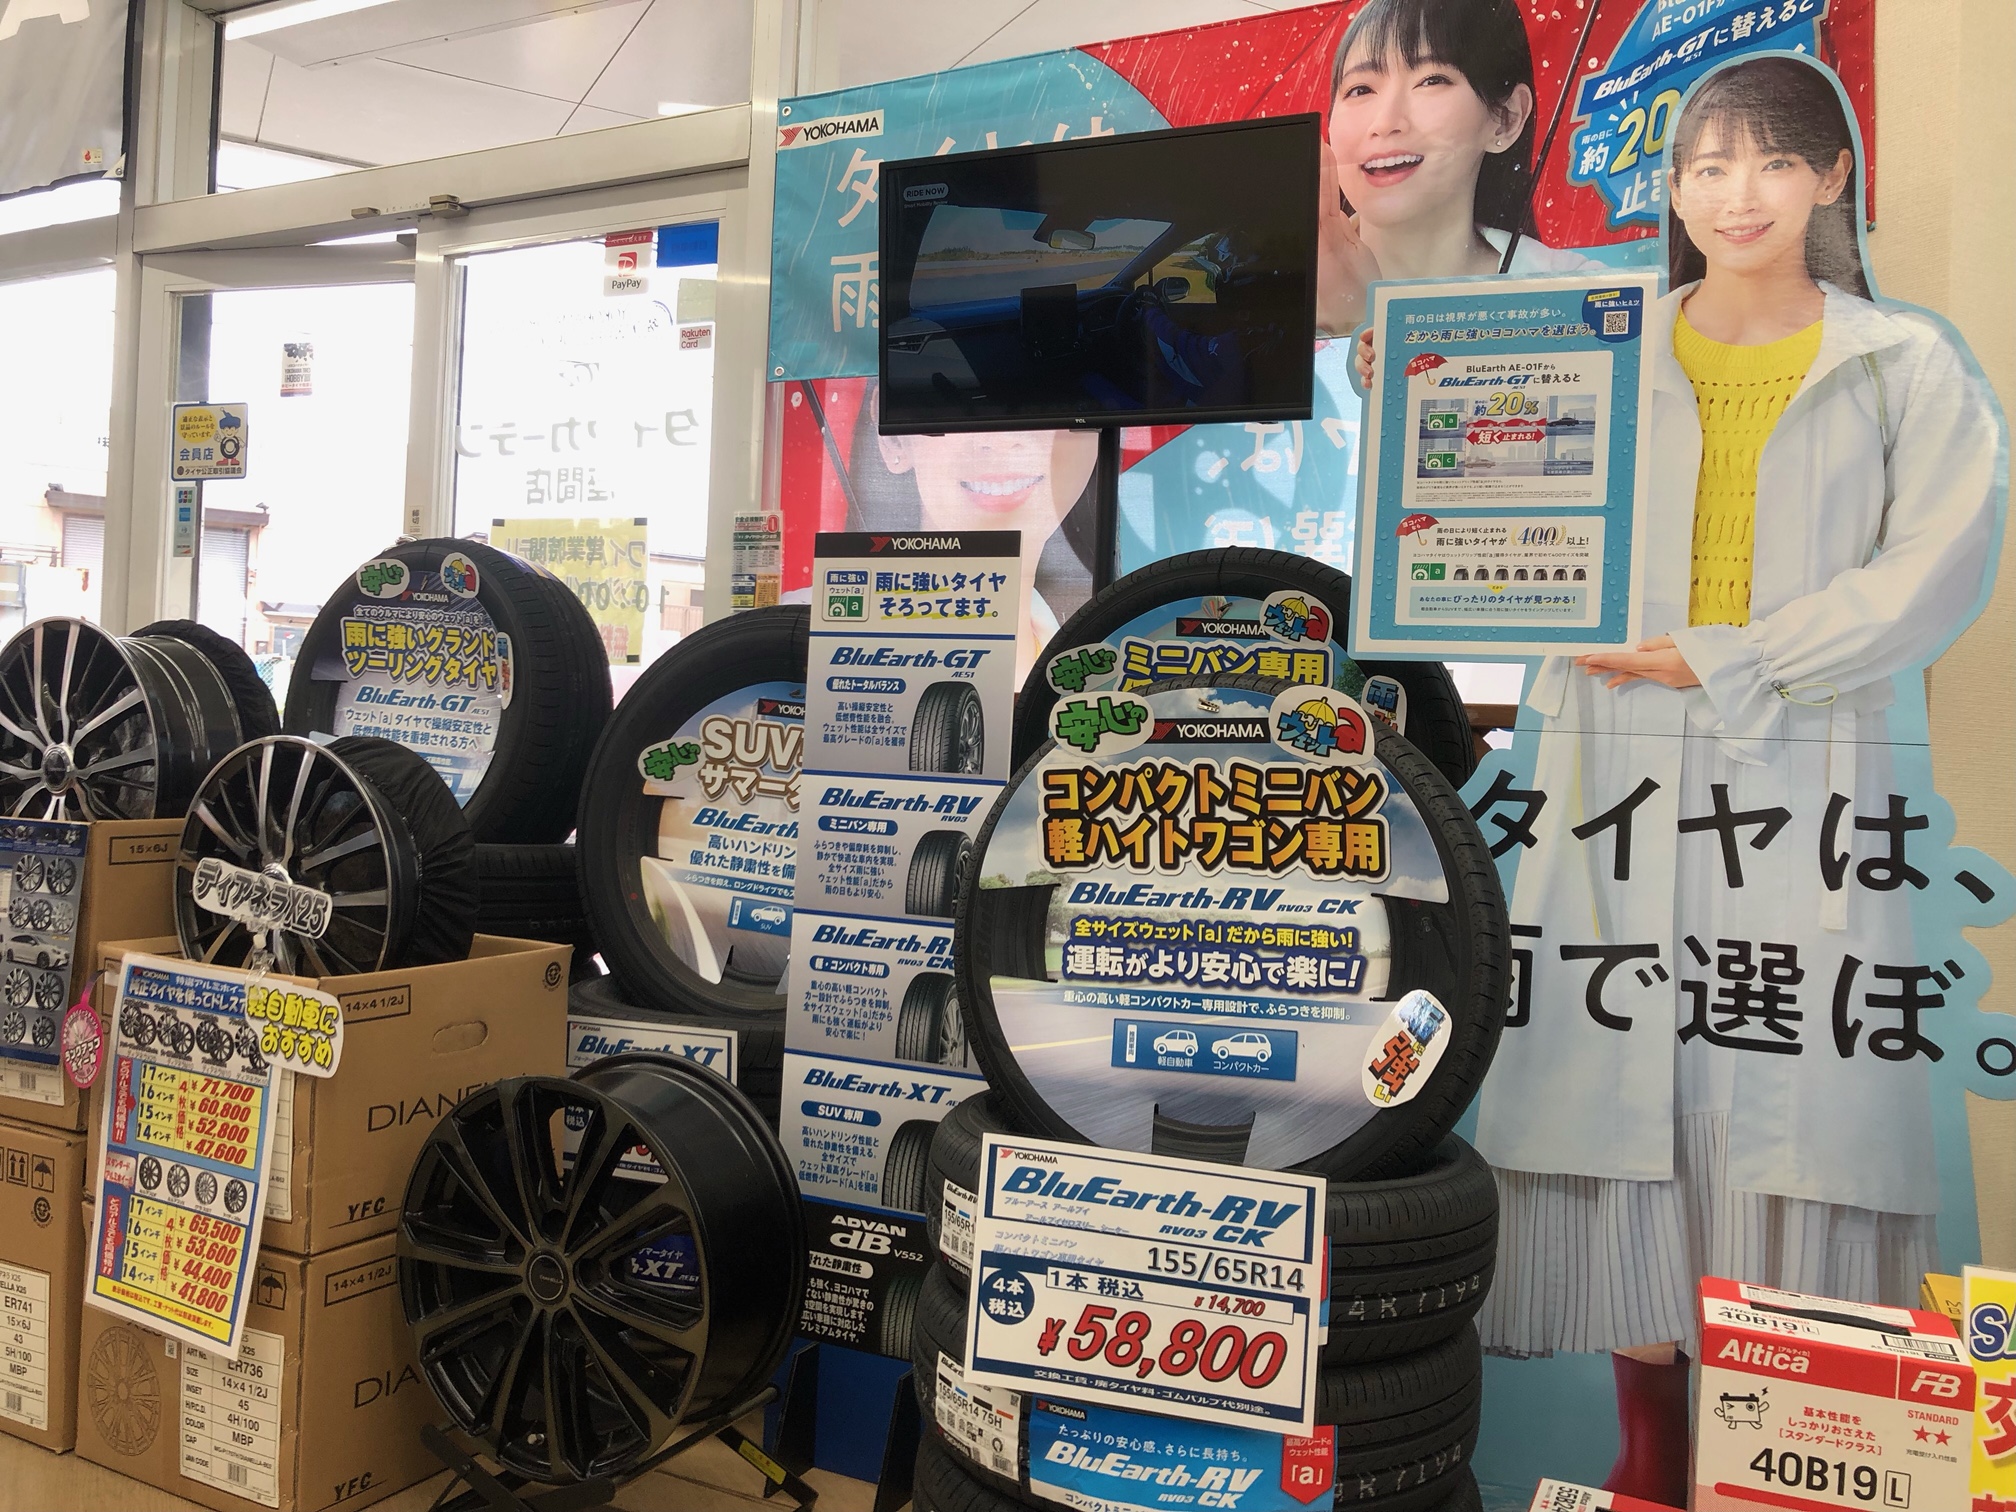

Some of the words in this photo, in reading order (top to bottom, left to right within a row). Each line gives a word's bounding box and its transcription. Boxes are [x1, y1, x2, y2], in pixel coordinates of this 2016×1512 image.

[1593, 27, 1714, 101] BluEarth-GT
[804, 117, 879, 142] YOKOHAMA
[1582, 129, 1613, 145] 雨の日に
[906, 188, 924, 198] RIDE
[925, 187, 945, 197] NOW
[612, 279, 641, 290] PayPay
[1405, 310, 1566, 325] 雨の日は視界が悪くて事故が多い。
[682, 329, 711, 338] Rakuten
[1404, 323, 1597, 344] だから雨に強いヨコハマを選ぼう。
[681, 340, 698, 348] Card
[1411, 355, 1436, 368] ヨコハマ
[1466, 364, 1506, 373] BluEarth
[1438, 374, 1535, 388] BluEarth-GT
[180, 447, 214, 460] 会員店
[1402, 516, 1427, 529] ヨコハマ
[892, 537, 961, 550] YOKOHAMA
[1436, 537, 1507, 546] 雨に強いタイヤが
[1517, 526, 1558, 546] 400
[1567, 537, 1589, 546] 以上!
[830, 573, 865, 583] 雨に強い
[875, 572, 1006, 592] 雨に強いタイヤ
[412, 592, 448, 602] YOKOHAMA
[829, 586, 865, 595] ウェット「a」
[880, 597, 998, 618] そろってます。
[1201, 622, 1266, 636] YOKOHAMA
[345, 621, 496, 660] 雨に強いグランド
[830, 647, 991, 669] BluEarth-GT
[1124, 642, 1326, 686] ミニバン専用
[346, 651, 497, 686] ツーリングタイヤ
[832, 679, 899, 690] 優れたトータルバランス
[356, 686, 477, 713] BluEarth-GT
[837, 702, 894, 713] 高い操縦安定性と
[346, 710, 493, 736] ウェット「a」タイヤで操縦安定性と
[836, 714, 894, 724] 低燃費性能を融合。
[352, 725, 478, 750] 低燃費性能を重視される方へ
[823, 723, 907, 735] ウェット性能は全サイズで
[1176, 723, 1265, 739] YOKOHAMA
[823, 734, 905, 747] 最高グレードの「a」を獲得
[1046, 764, 1379, 818] コンパクトミニバン
[819, 787, 983, 815] BluEarth-RV
[829, 818, 887, 833] ミニバン専用
[941, 815, 968, 823] RV03
[1046, 816, 1381, 872] 軽ハイトワゴン専用
[1471, 769, 1995, 904] タイヤは、
[690, 850, 795, 880] 優れた静粛性を備
[817, 851, 897, 866] 静かで快適な車内を実現。
[828, 863, 884, 876] 全サイズ雨に強い
[818, 874, 893, 888] ウェット性能「a」だから
[825, 885, 884, 900] 雨の日もより安心。
[1068, 882, 1286, 912] BluEarth-RV
[1277, 905, 1313, 913] RV03
[1316, 898, 1364, 914] CK
[812, 925, 955, 956] BluEarth-R
[1074, 919, 1354, 948] 全サイズウェット「a」だから雨に強い!
[815, 958, 884, 977] 軽・コンパクト専用
[898, 958, 924, 967] RV03
[1066, 944, 1362, 989] 運転がより安心で楽に!
[142, 968, 169, 981] YOKOHAMA
[811, 980, 888, 997] 重心の高い軽コンパクト
[248, 984, 339, 1035] 軽自動車に
[805, 991, 892, 1011] カー設計でふらつきを抑制。
[1063, 990, 1352, 1021] 重心の高い軽コンパクトカー専用設計で、ふらつきを抑制。
[803, 1002, 893, 1021] 全サイズウェット「a」だから
[812, 1014, 882, 1032] 雨にも強く運転がより
[825, 1028, 866, 1041] 安心で楽に!
[261, 1024, 333, 1070] おすすめ
[1157, 1056, 1193, 1068] 軽自動車
[1213, 1061, 1269, 1073] コンパクトカー
[803, 1068, 951, 1104] BluEarth-XT
[818, 1105, 842, 1119] SUV
[566, 1116, 585, 1128] 税込
[802, 1126, 879, 1146] 高いハンドリング性能と
[803, 1138, 876, 1158] 優れた静粛性を備える。
[822, 1152, 857, 1166] 全サイズで
[1013, 1152, 1058, 1164] YOKOHAMA
[800, 1160, 878, 1182] ウェット最高グレード「a」
[799, 1170, 878, 1193] 低燃費グレード「A」を獲得
[1002, 1167, 1302, 1228] BluEarth-RV
[1004, 1197, 1048, 1210] ブルーアース
[348, 1198, 386, 1220] YFC
[831, 1215, 906, 1237] ADVAN
[994, 1230, 1077, 1249] コンパクトミニバン
[1159, 1225, 1207, 1239] RV03
[1212, 1225, 1275, 1248] CK
[830, 1230, 892, 1255] dB
[894, 1249, 924, 1262] V552
[1147, 1248, 1303, 1290] 155/65R14
[992, 1279, 1024, 1295] 4本
[1050, 1271, 1088, 1292] 1本
[1098, 1276, 1144, 1300] 税込
[5, 1295, 33, 1314] ER741
[988, 1298, 1025, 1318] 税込
[1718, 1311, 1799, 1331] 40B19
[1720, 1306, 1758, 1317] Altica
[1761, 1314, 1810, 1324] STANDARD
[14, 1333, 24, 1344] 43
[1038, 1304, 1288, 1389] ¥58,800
[5, 1347, 32, 1362] 5H/100
[1718, 1338, 1809, 1374] Altica
[10, 1363, 28, 1376] MBP
[186, 1367, 198, 1377] SIZE
[186, 1385, 202, 1395] INSET
[248, 1383, 268, 1399] 1/2J
[354, 1364, 420, 1408] DIA
[1911, 1370, 1962, 1398] FB
[238, 1399, 249, 1411] 45
[939, 1383, 979, 1417] 155/65R14
[982, 1410, 1002, 1429] 75H
[1049, 1404, 1085, 1419] YOKOHAMA
[186, 1417, 205, 1430] COLOR
[227, 1414, 260, 1432] 4H/100
[1803, 1406, 1862, 1426] 基本性能を
[1908, 1409, 1959, 1426] STANDARD
[1788, 1417, 1876, 1442] しっかりおさえた
[185, 1434, 197, 1444] CAP
[232, 1432, 254, 1446] MBP
[1058, 1424, 1250, 1462] たっぷりの安心感、さらに長持ち。
[1286, 1438, 1332, 1446] 最高グレードの
[1779, 1428, 1882, 1456] [スタンダードクラス]
[1289, 1448, 1328, 1457] ウェット性能
[1906, 1449, 1957, 1463] 充電受け入れ性能
[195, 1457, 209, 1468] CODE
[1045, 1440, 1263, 1492] BluEarth-RV
[1750, 1448, 1878, 1502] 40B19
[1890, 1477, 1903, 1502] L
[334, 1472, 372, 1500] YFC
[1158, 1493, 1193, 1504] RV03
[1197, 1491, 1243, 1509] CK
